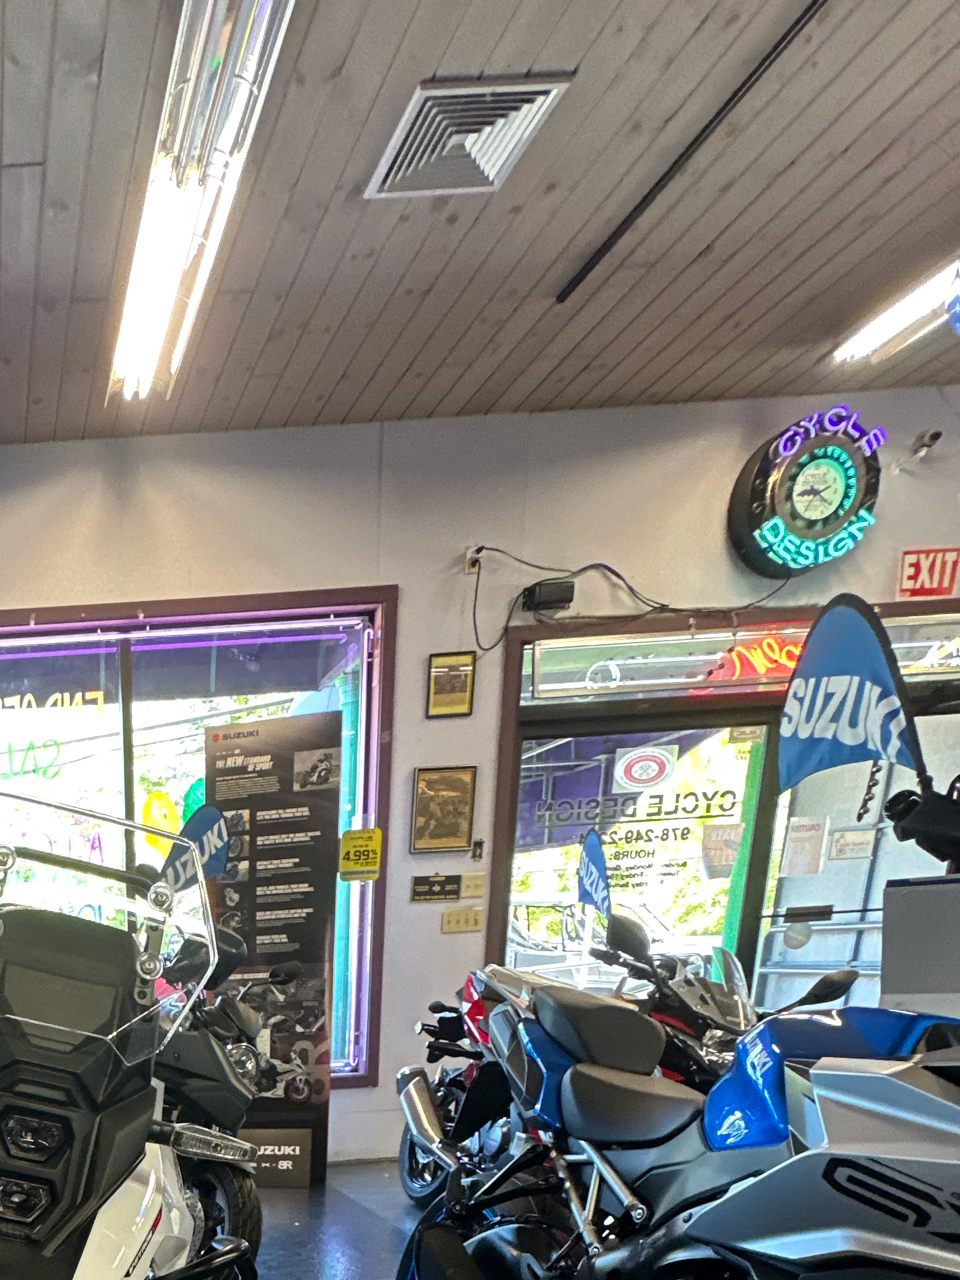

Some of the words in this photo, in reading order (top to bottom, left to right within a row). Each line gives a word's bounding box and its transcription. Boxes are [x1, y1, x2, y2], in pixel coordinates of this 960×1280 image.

[778, 404, 889, 457] CYCLE
[760, 508, 876, 565] DESIGN
[901, 551, 958, 589] EXIT
[222, 729, 259, 741] SUZUKI
[780, 675, 907, 764] SUZUKI
[226, 755, 245, 767] NEW
[161, 818, 229, 890] UZUKI
[580, 850, 609, 918] SUZUKI
[257, 1145, 300, 1155] UZUKI
